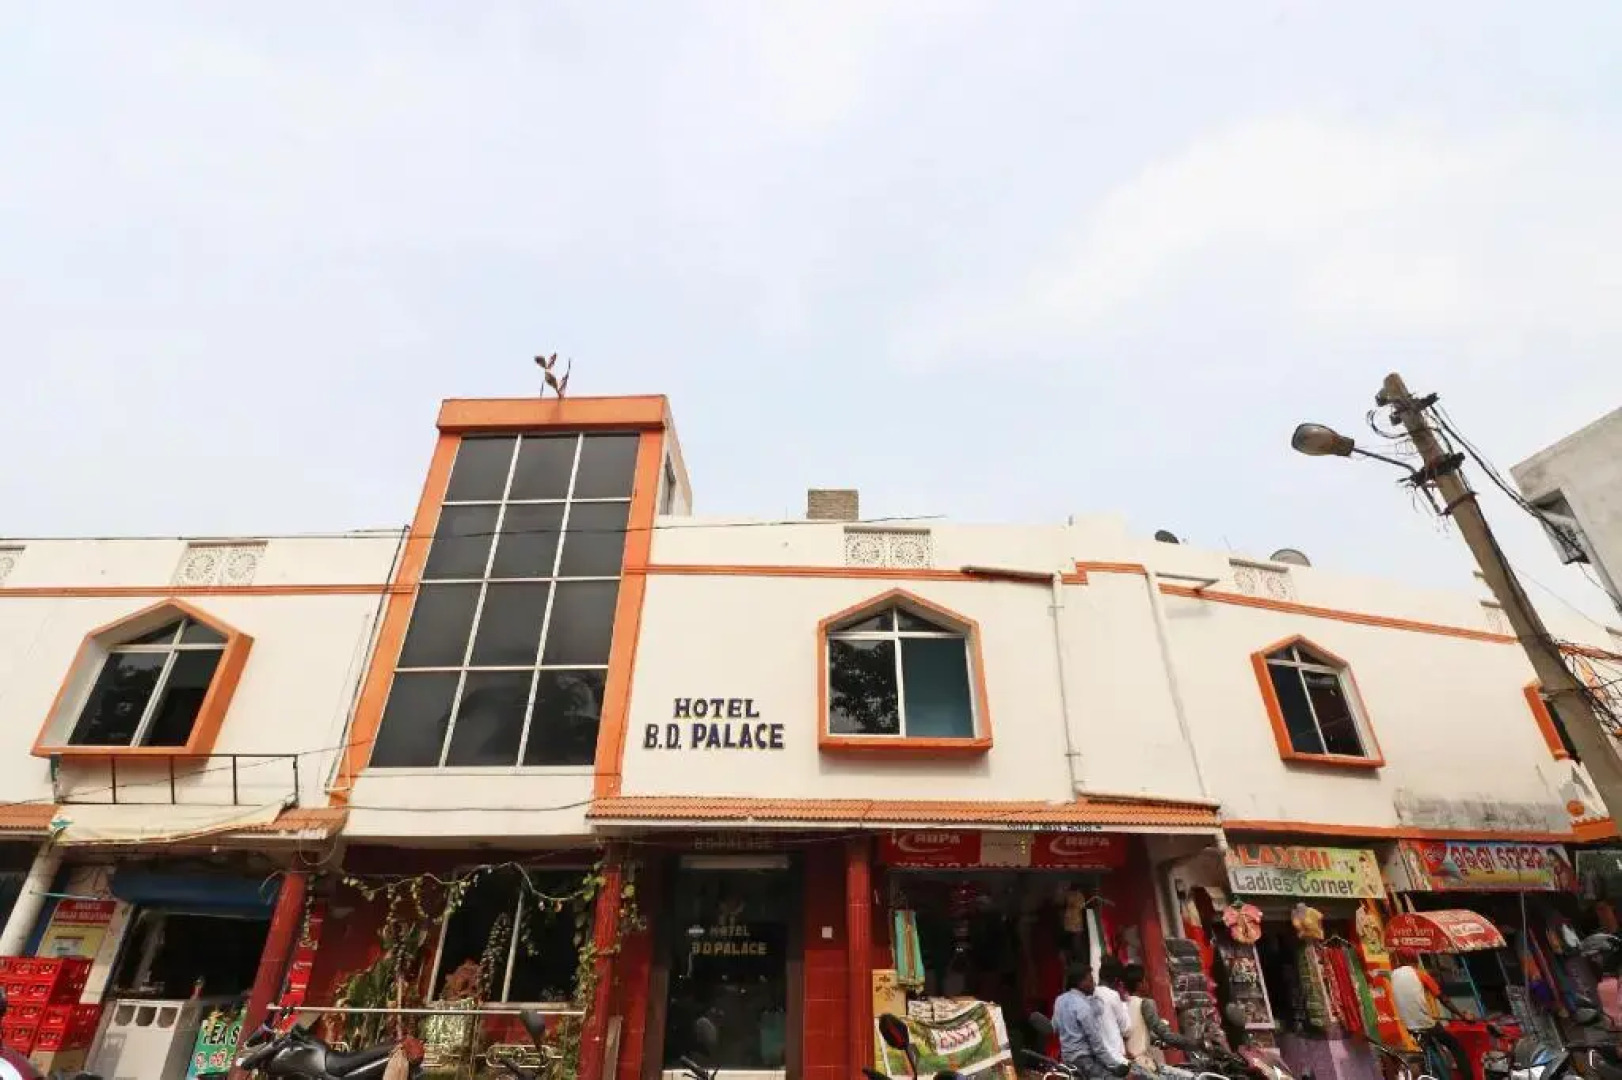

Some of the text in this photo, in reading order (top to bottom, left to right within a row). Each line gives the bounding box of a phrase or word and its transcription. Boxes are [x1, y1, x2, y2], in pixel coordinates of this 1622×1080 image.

[673, 698, 760, 718] HOTEL
[644, 723, 785, 749] B.D. PALACE
[1237, 845, 1331, 871] LAXMI
[1233, 871, 1355, 895] Ladies Corner
